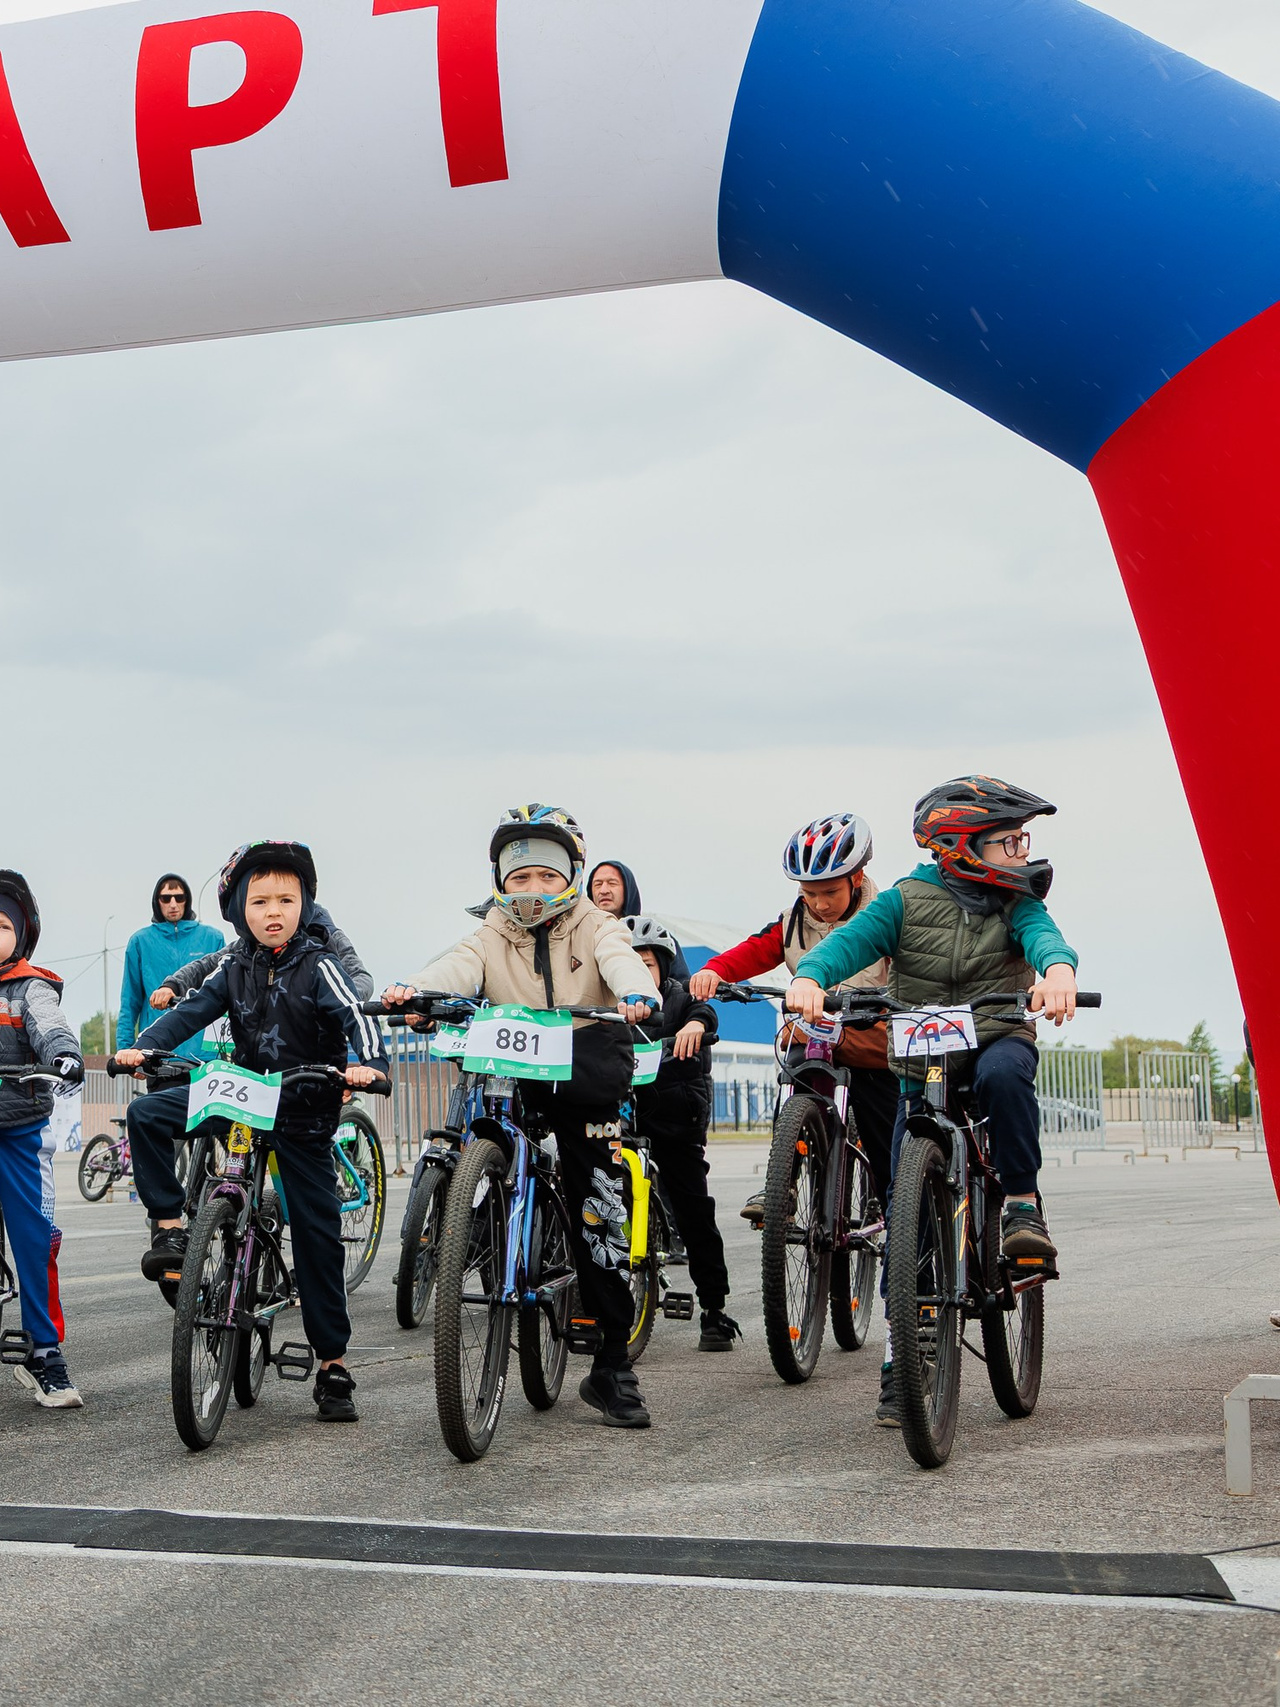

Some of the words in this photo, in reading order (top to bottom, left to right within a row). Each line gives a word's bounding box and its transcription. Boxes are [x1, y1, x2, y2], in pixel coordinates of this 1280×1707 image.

[496, 1028, 540, 1055] 881
[904, 1020, 965, 1046] 144
[207, 1079, 249, 1102] 926
